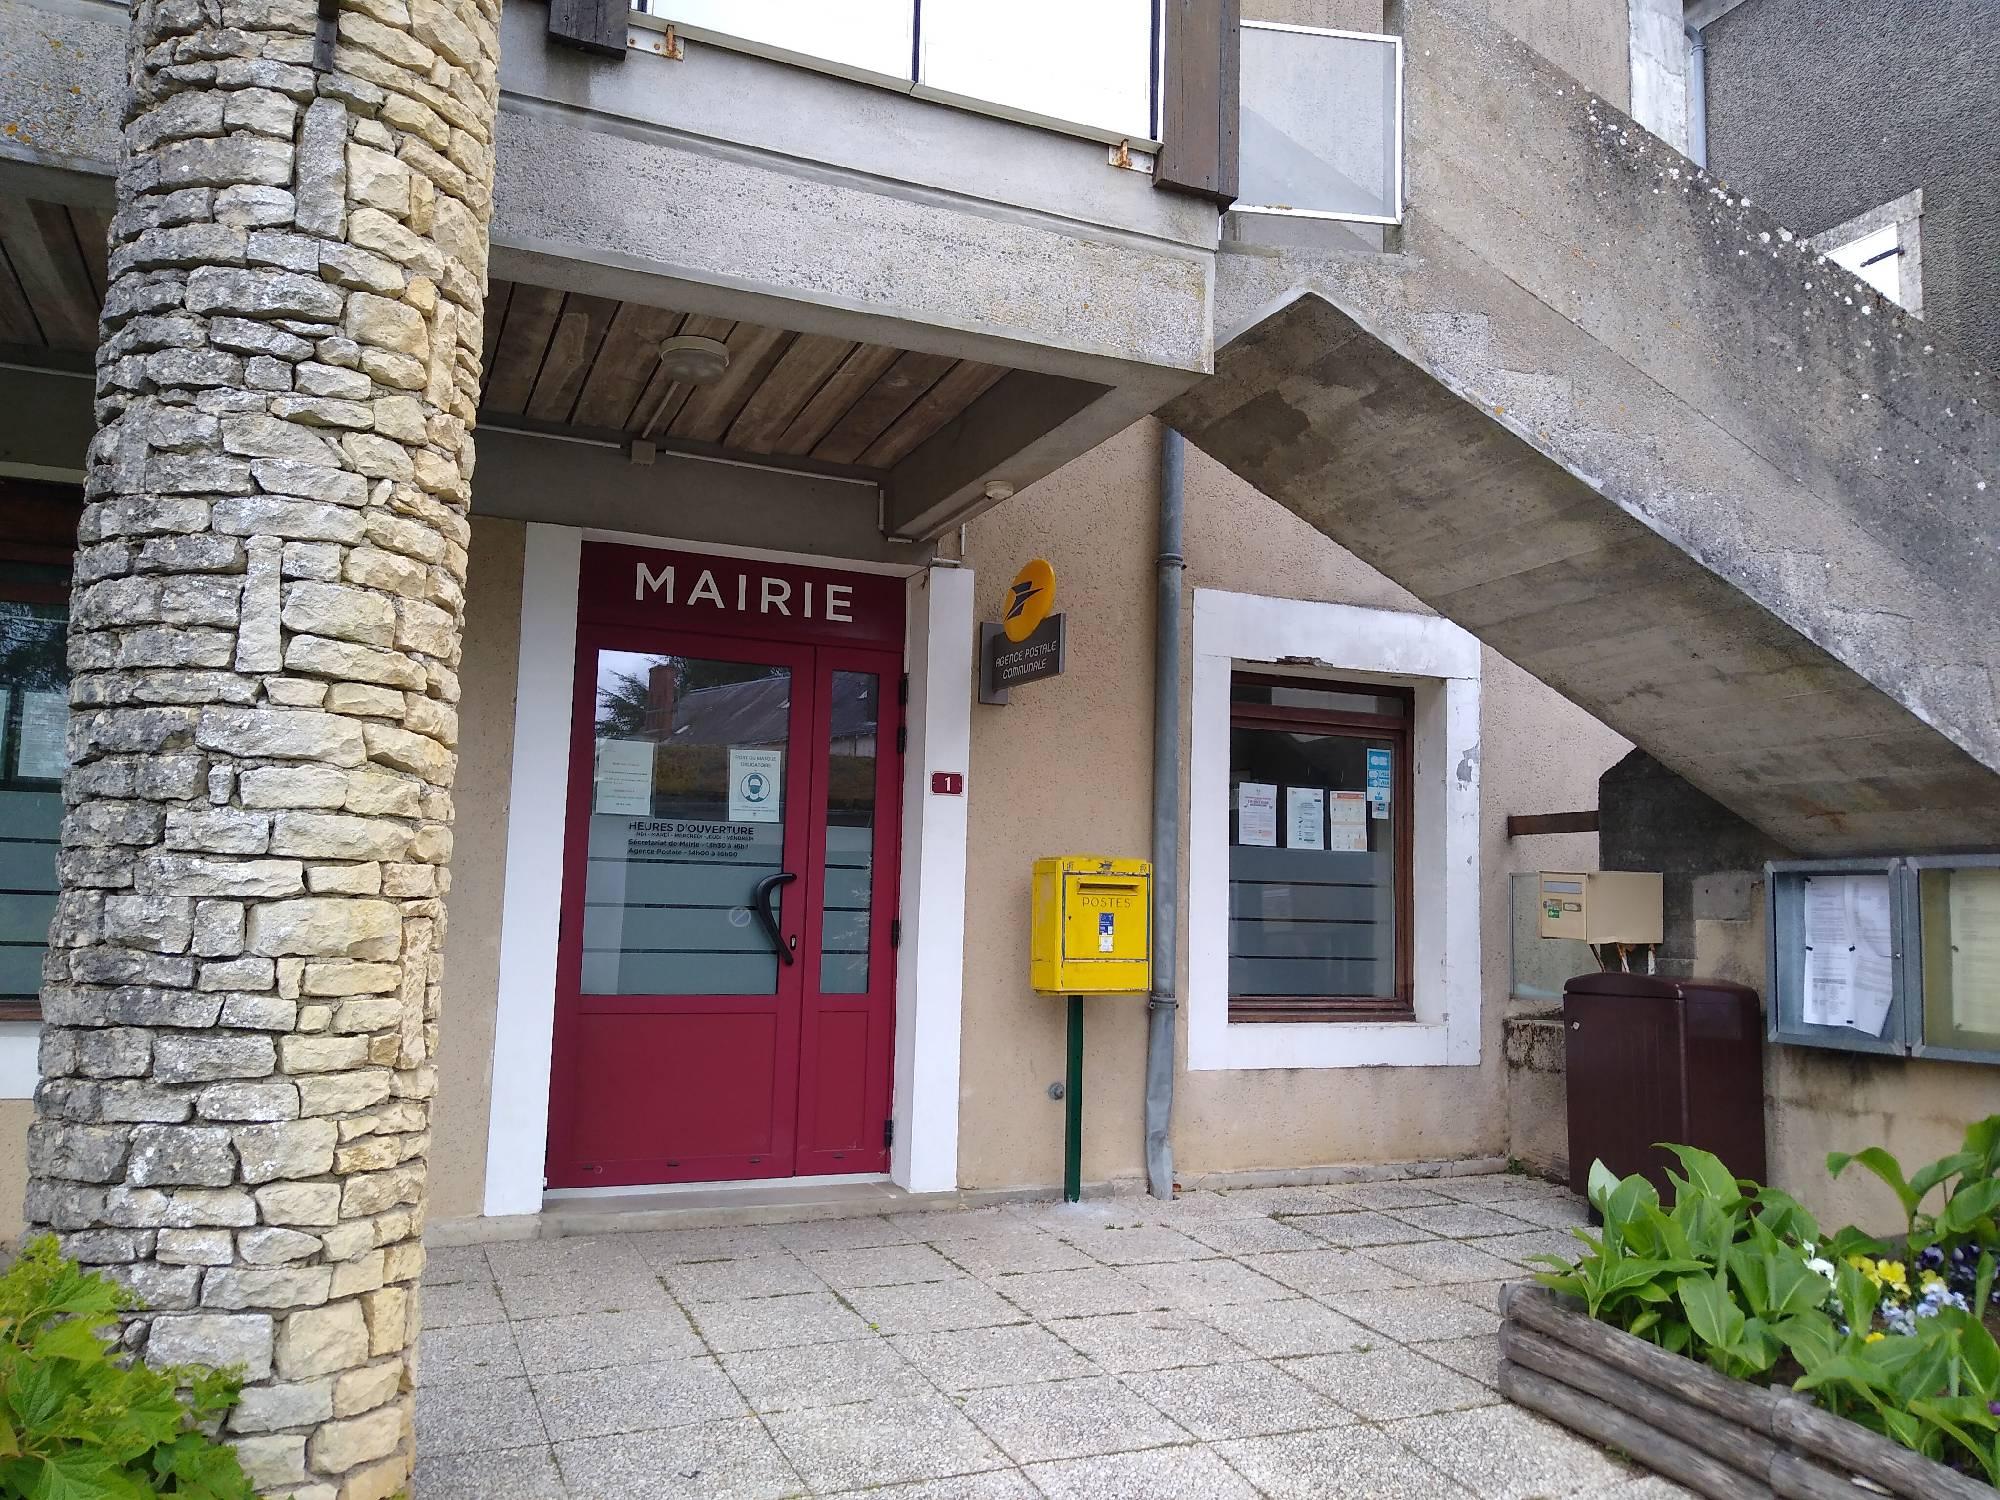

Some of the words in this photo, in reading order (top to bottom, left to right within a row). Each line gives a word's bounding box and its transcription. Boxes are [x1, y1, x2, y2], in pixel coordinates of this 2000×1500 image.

[635, 562, 853, 623] MAIRIE
[995, 650, 1023, 668] AGENCE
[1024, 640, 1057, 659] POSTALE
[1002, 658, 1047, 679] COMMUNALE
[944, 776, 951, 791] 1
[629, 821, 674, 833] HEURES
[677, 823, 755, 835] D'OUVERTURE
[628, 847, 655, 855] Agence
[1082, 896, 1131, 908] POSTES
